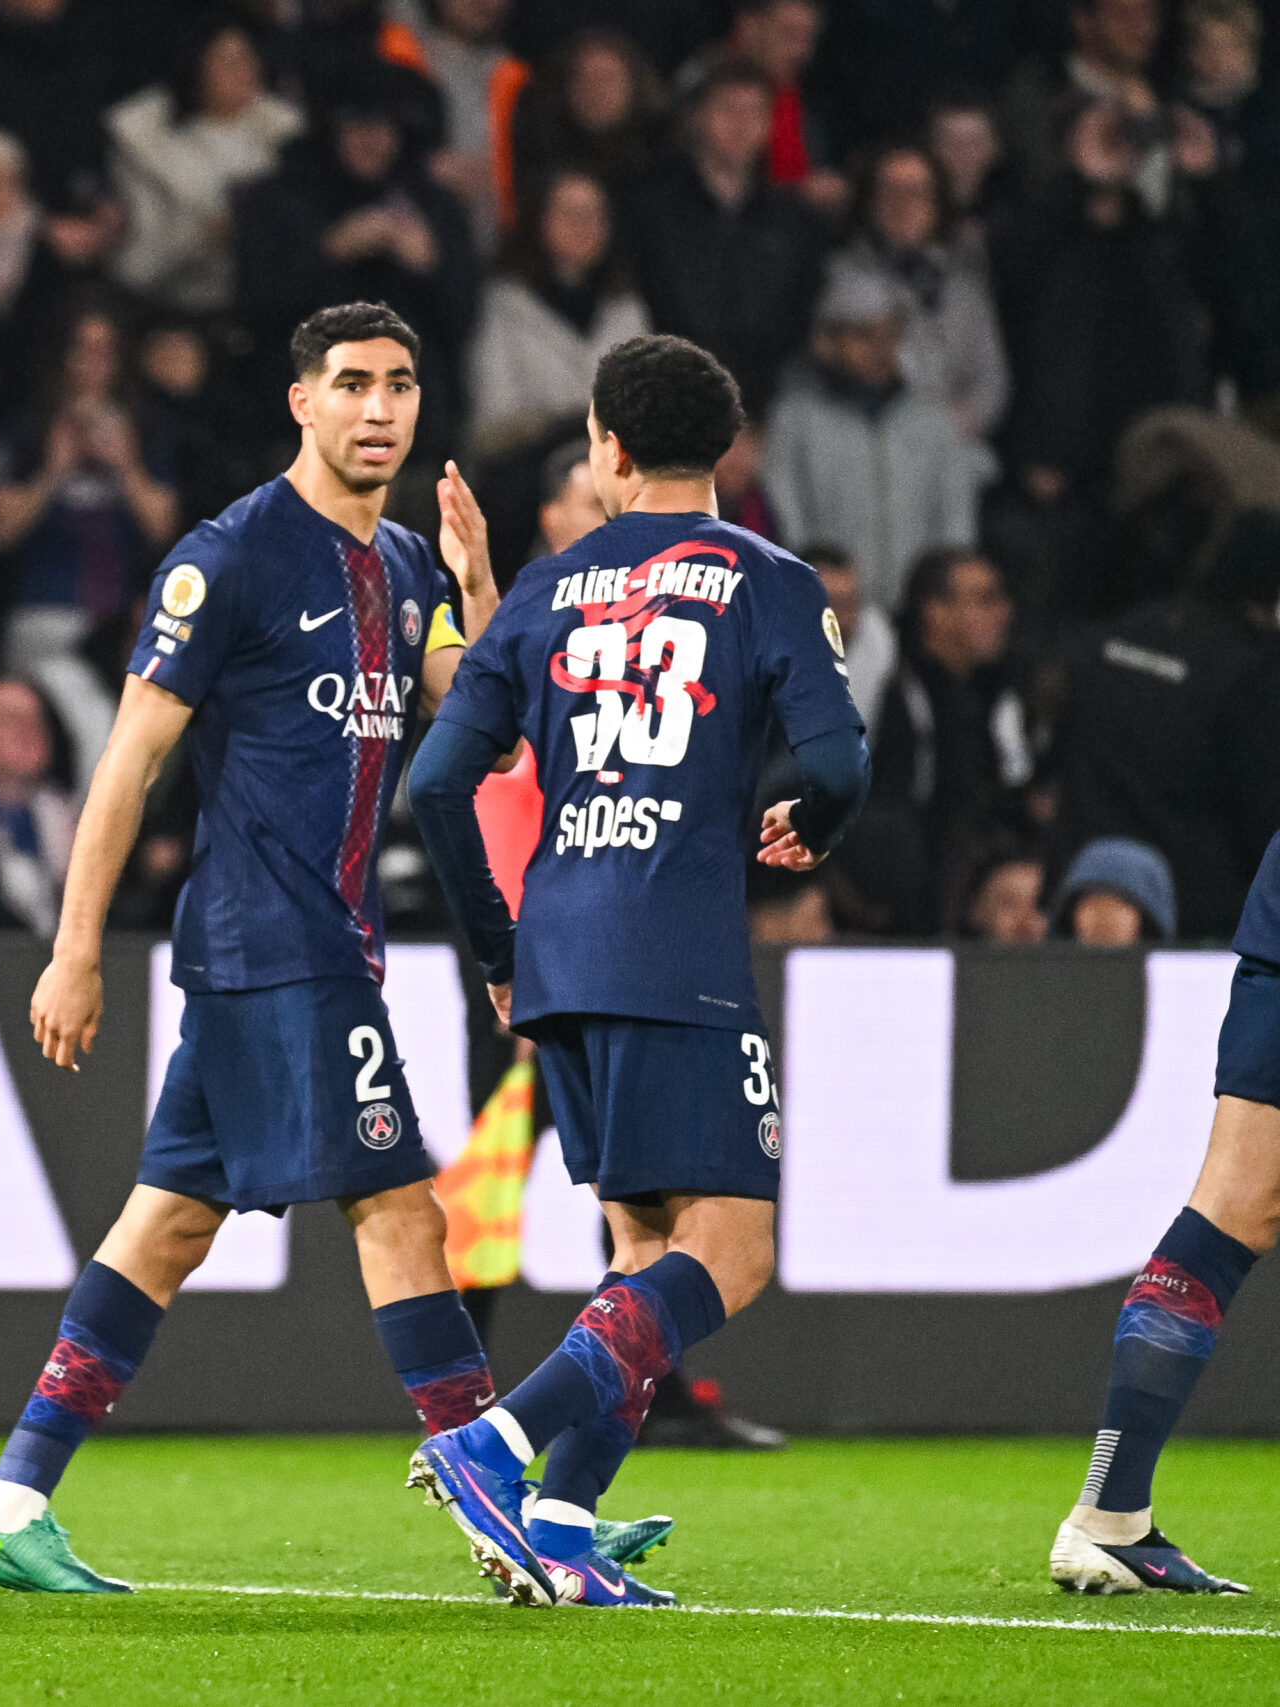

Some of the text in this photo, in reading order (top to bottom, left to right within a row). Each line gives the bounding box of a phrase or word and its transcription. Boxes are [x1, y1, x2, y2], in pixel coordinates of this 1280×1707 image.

[551, 561, 744, 612] ZAÏRE-EMERY
[566, 615, 707, 773] 33
[348, 1025, 391, 1103] 2
[741, 1032, 780, 1111] 3
